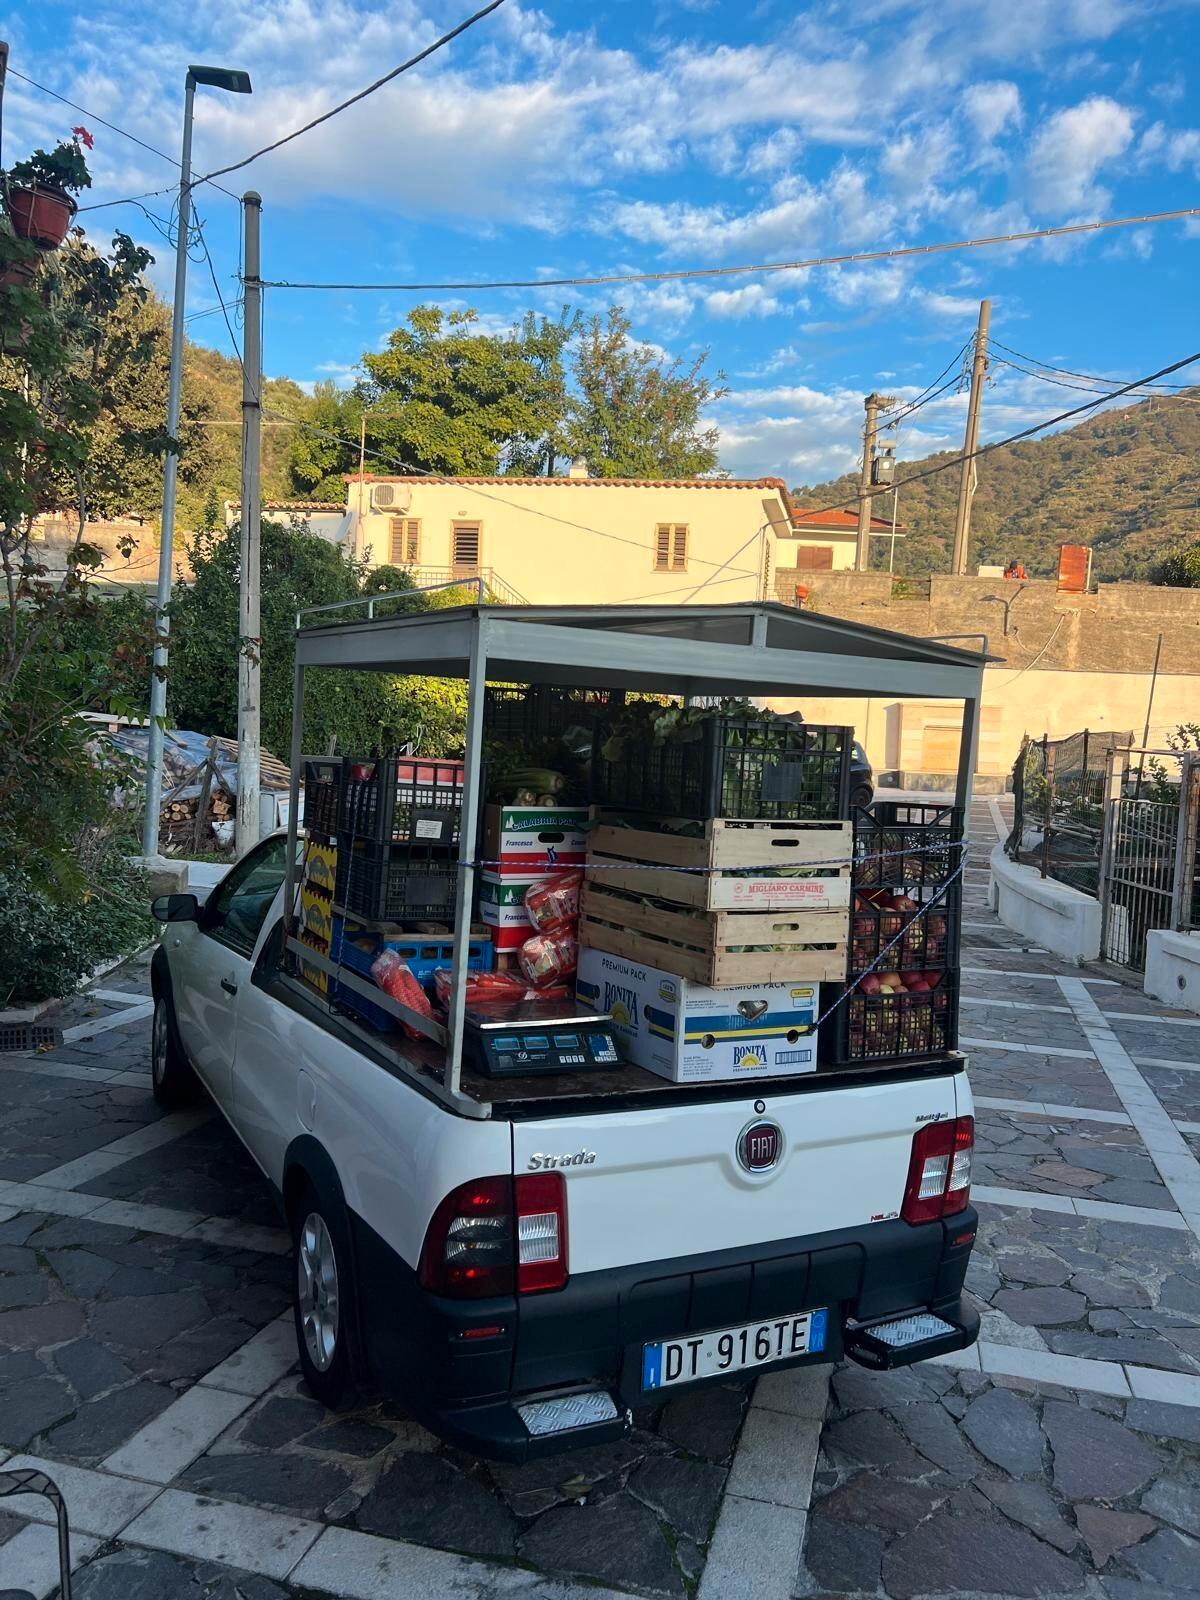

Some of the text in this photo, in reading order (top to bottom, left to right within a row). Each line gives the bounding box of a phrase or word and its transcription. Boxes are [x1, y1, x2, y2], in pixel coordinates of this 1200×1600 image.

[505, 839, 533, 847] Francesco
[748, 884, 825, 894] MIGLIARO CARMINE
[602, 958, 647, 982] PREMIUM PACK
[604, 981, 640, 1026] BONITA
[733, 1044, 768, 1065] BONITA
[527, 1147, 597, 1171] Strada
[751, 1135, 774, 1160] FIAT
[665, 1339, 704, 1382] DT
[717, 1317, 808, 1370] 916TE
